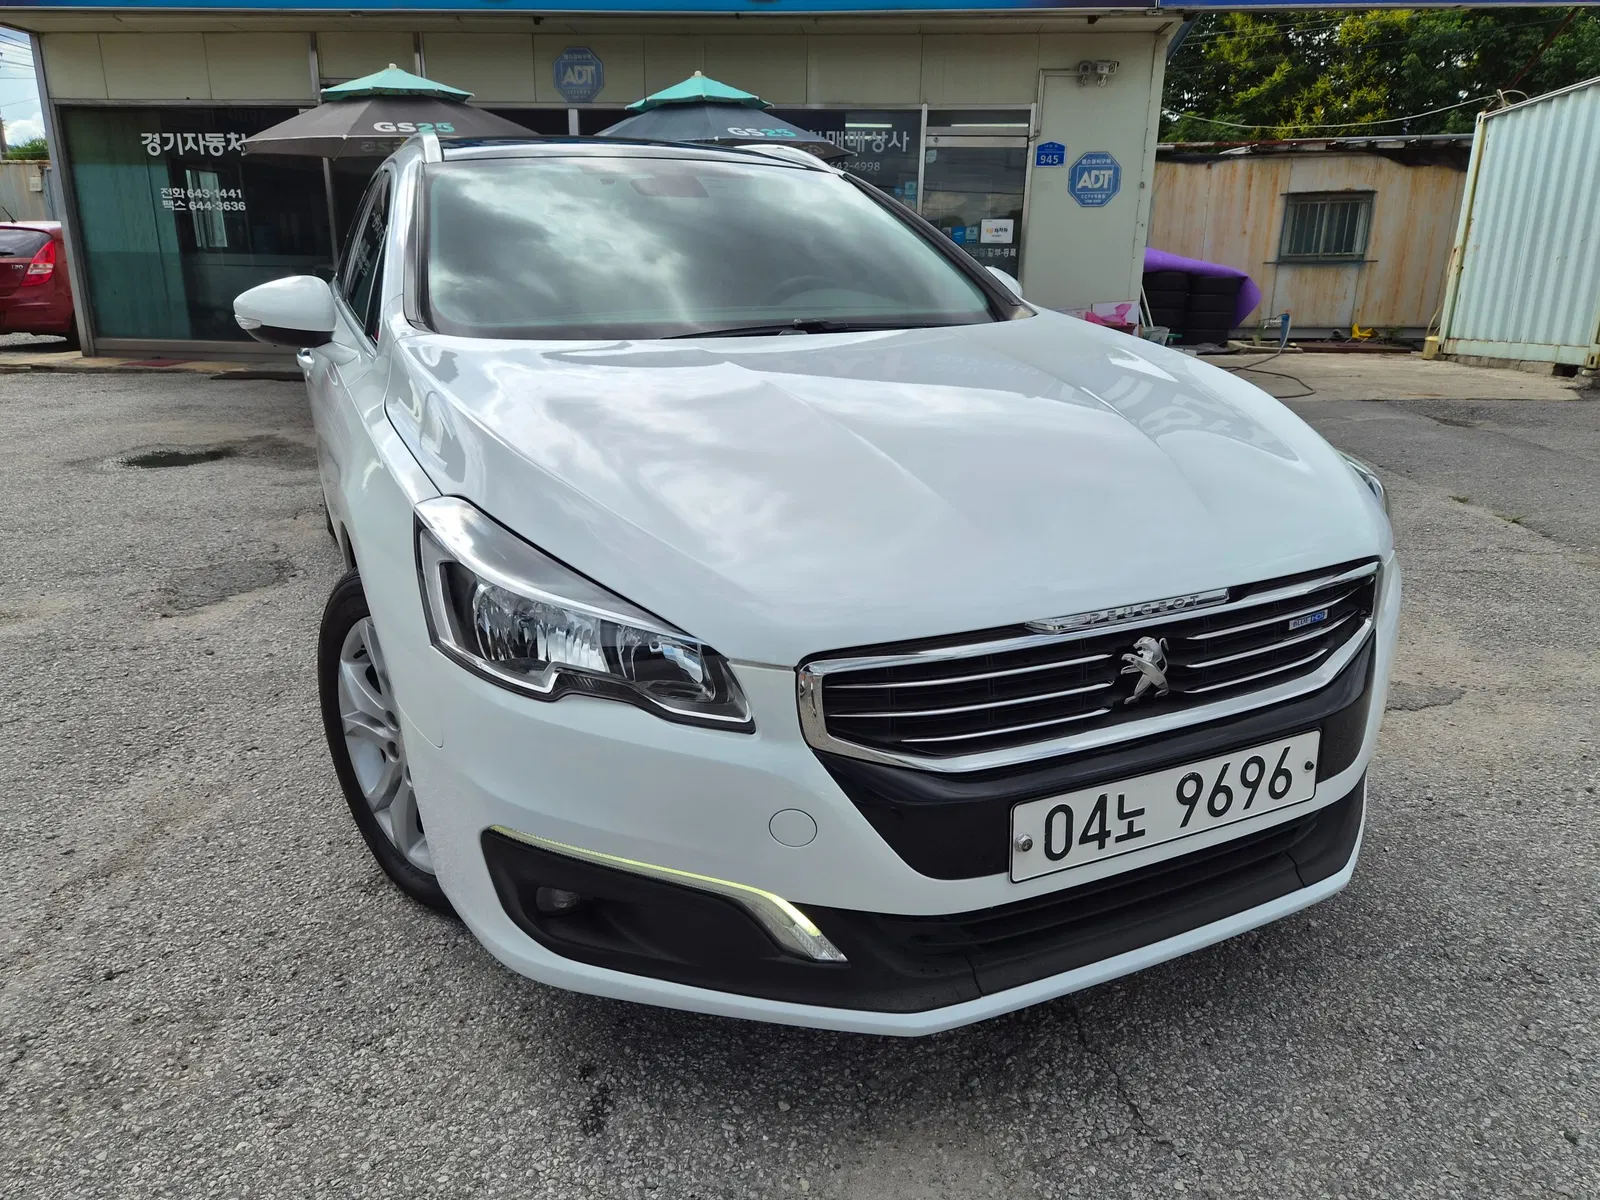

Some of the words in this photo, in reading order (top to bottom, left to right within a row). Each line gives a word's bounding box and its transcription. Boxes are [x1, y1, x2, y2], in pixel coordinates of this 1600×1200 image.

[562, 65, 595, 85] ADT
[373, 122, 455, 132] GS25
[727, 128, 796, 136] GS25
[141, 132, 247, 156] 경기자동차
[809, 130, 909, 152] 매매상사
[1040, 155, 1059, 164] 945
[1077, 170, 1113, 189] ADT
[161, 188, 185, 199] 전화
[187, 189, 242, 198] 643-1441
[162, 200, 187, 211] 팩스
[189, 202, 246, 211] 644-3636
[1089, 594, 1200, 624] PEUGEOT
[1044, 792, 1146, 862] 04노
[1176, 746, 1293, 828] 9696
